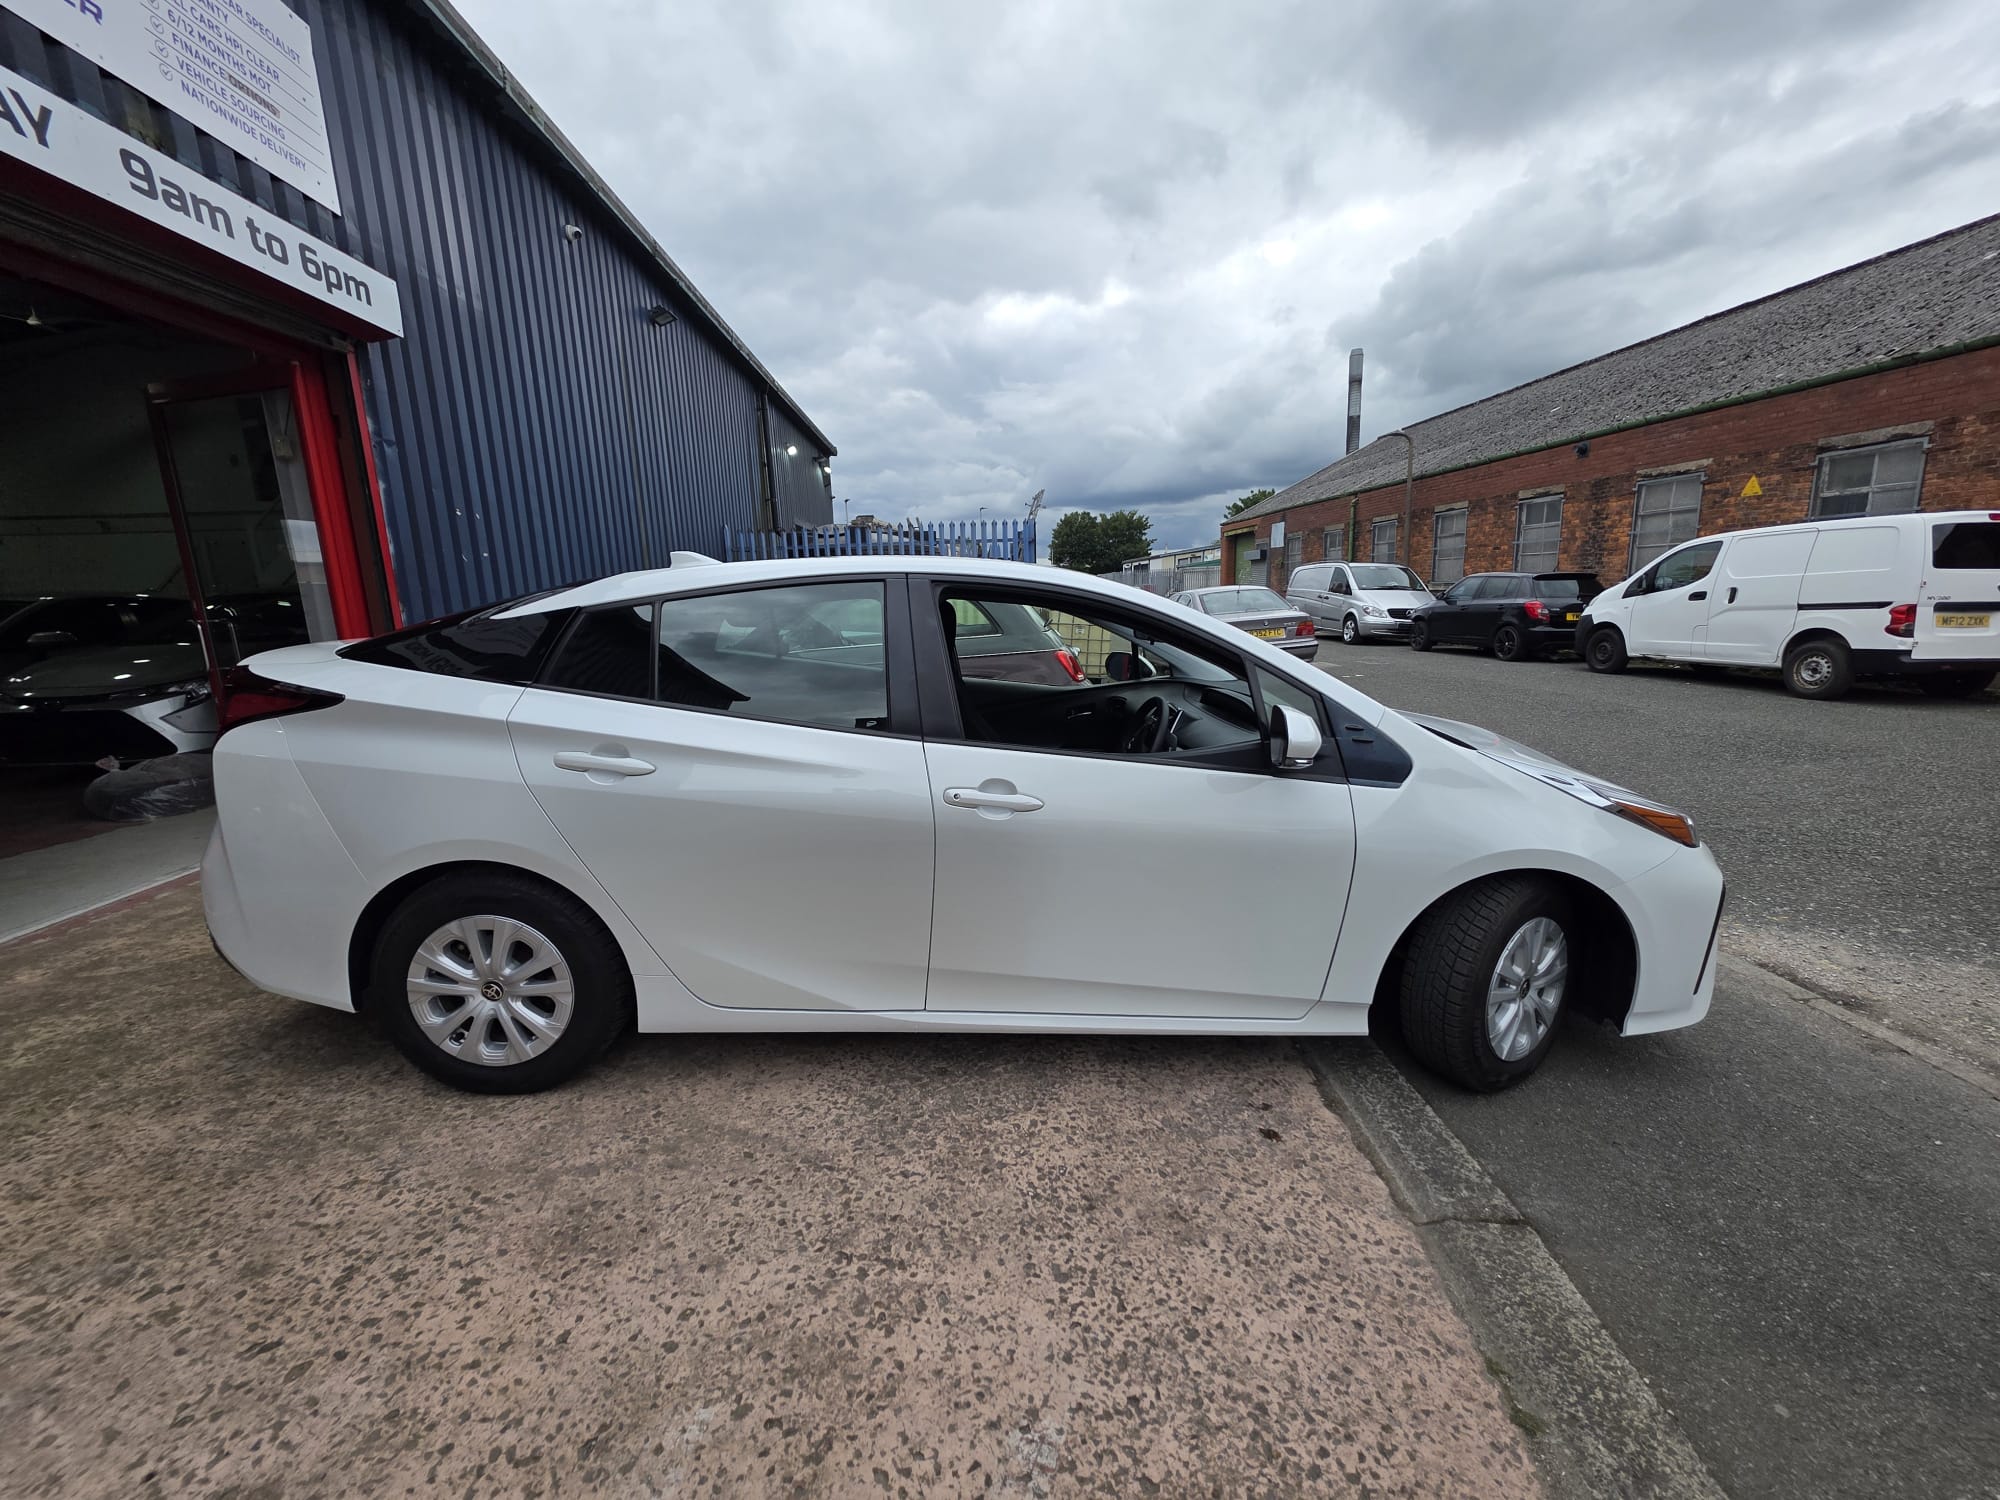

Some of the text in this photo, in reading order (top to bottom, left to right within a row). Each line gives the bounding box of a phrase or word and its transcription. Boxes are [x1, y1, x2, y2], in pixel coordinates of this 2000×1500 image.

[168, 9, 271, 95] 6/12 MONTHS MOT
[172, 32, 278, 116] FINANCE OPTIONS
[190, 6, 222, 38] CARS
[224, 31, 244, 56] HPI
[246, 48, 280, 83] CLEAR
[245, 11, 301, 65] SPECIALIST
[176, 55, 285, 140] VEHICLE SOURCING
[181, 80, 306, 171] NATIONWIDE DELIVERY
[119, 148, 235, 240] 9am
[245, 216, 289, 266] to
[298, 242, 372, 306] 6pm
